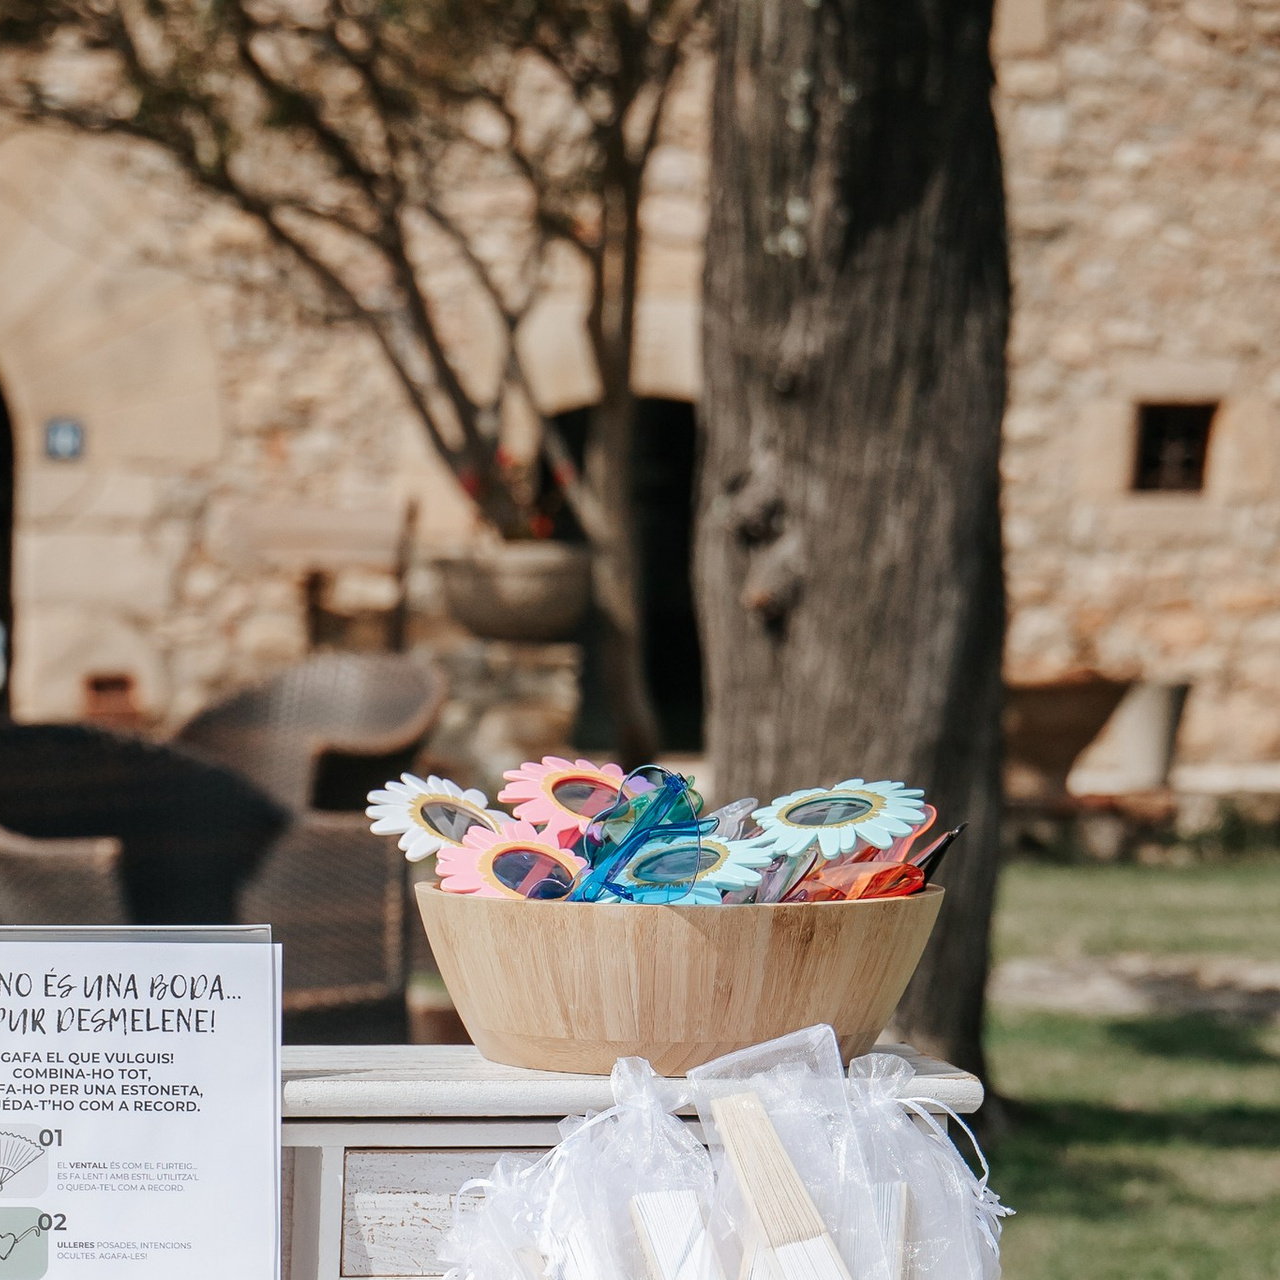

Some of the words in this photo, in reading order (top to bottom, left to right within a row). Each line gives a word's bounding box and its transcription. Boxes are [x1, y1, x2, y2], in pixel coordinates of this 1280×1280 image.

[44, 968, 77, 998] ÉS
[84, 973, 138, 1001] UNA
[150, 974, 241, 1000] BODA...
[57, 1007, 215, 1035] DESMELENE!
[47, 1052, 64, 1063] EL
[68, 1053, 100, 1065] QUE
[104, 1053, 173, 1064] VULGUIS!
[13, 1068, 114, 1079] COMBINA-HO
[118, 1069, 151, 1081] TOT,
[50, 1084, 78, 1095] PER
[84, 1084, 116, 1095] UNA
[122, 1085, 203, 1098] ESTONETA,
[79, 1101, 113, 1111] COM
[119, 1101, 129, 1111] A
[134, 1101, 200, 1112] RECORD.
[39, 1129, 62, 1146] 01
[110, 1161, 120, 1169] ÉS
[38, 1214, 66, 1230] 02
[97, 1242, 138, 1250] POSADES,
